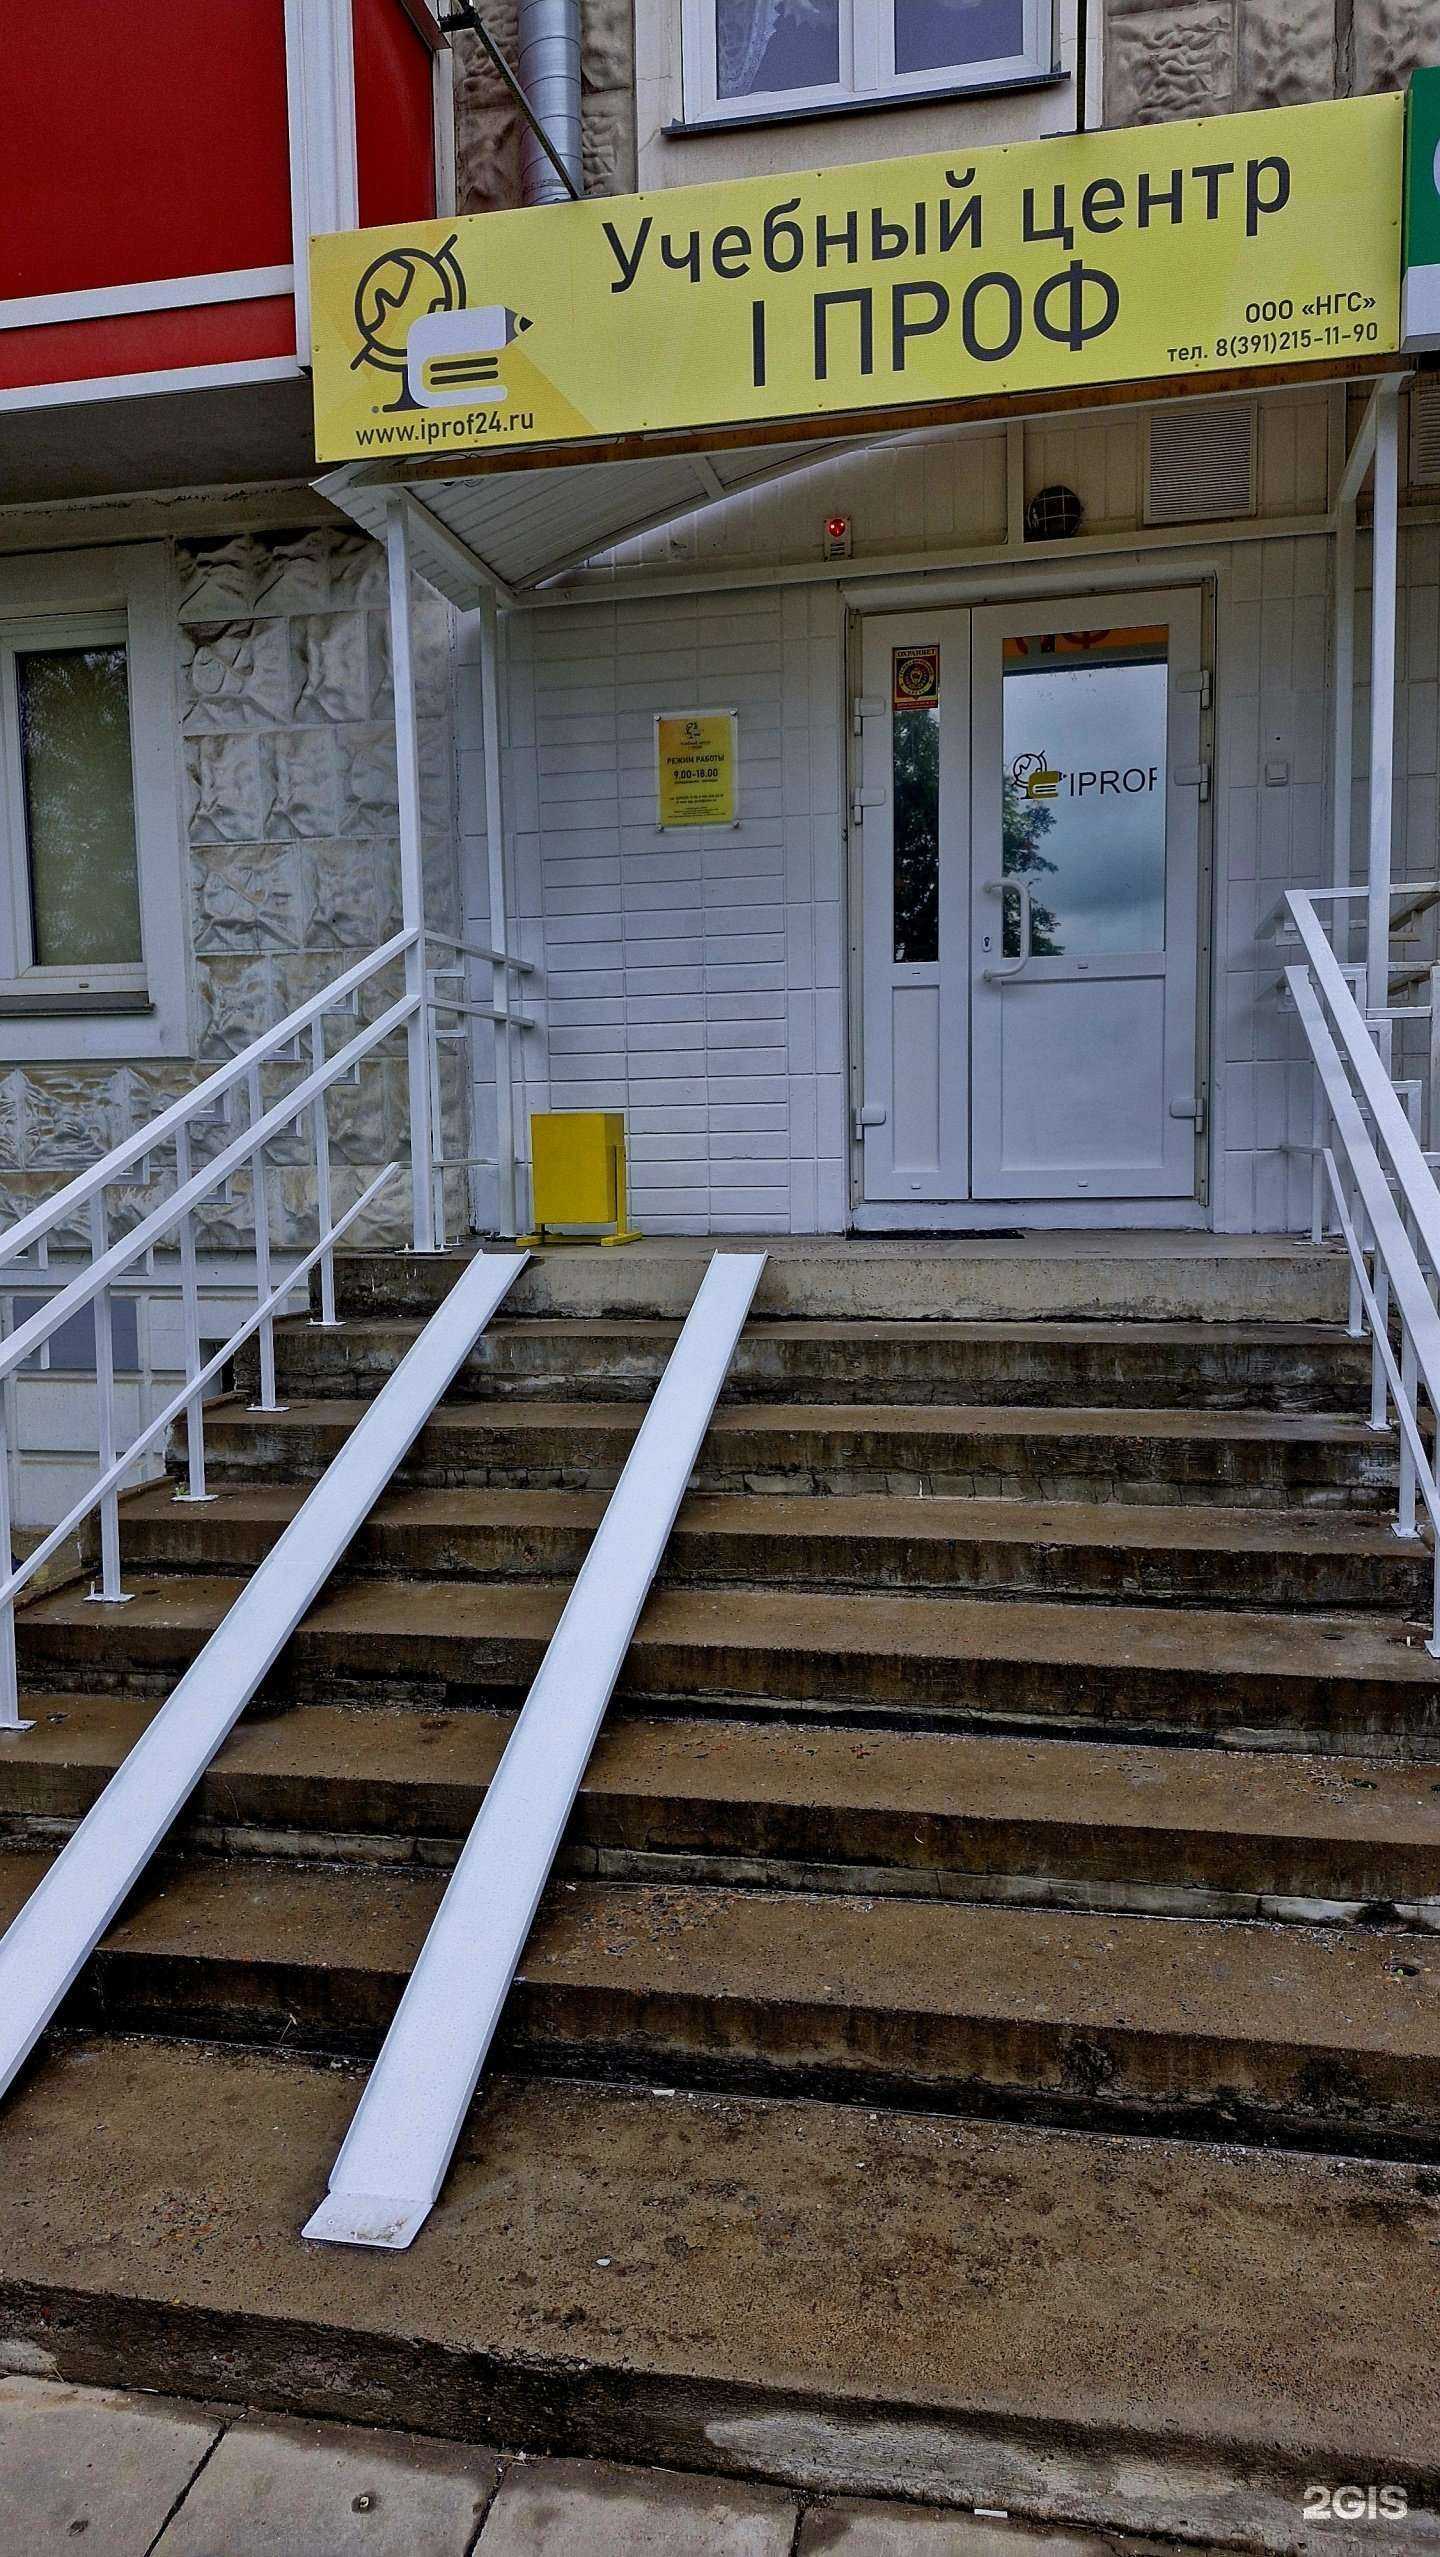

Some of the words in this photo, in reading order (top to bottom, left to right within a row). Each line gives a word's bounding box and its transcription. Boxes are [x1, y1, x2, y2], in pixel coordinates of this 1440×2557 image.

[602, 168, 982, 293] Учебный
[1023, 156, 1291, 250] центр
[814, 259, 1120, 380] ПРОФ
[1246, 299, 1293, 323] ООО
[1302, 291, 1376, 316] «НГС»
[1167, 344, 1208, 362] тел.
[1216, 322, 1378, 358] 8(391)215-11-90
[356, 411, 534, 445] www.iprof24.ru
[696, 753, 725, 763] РАБОТЫ
